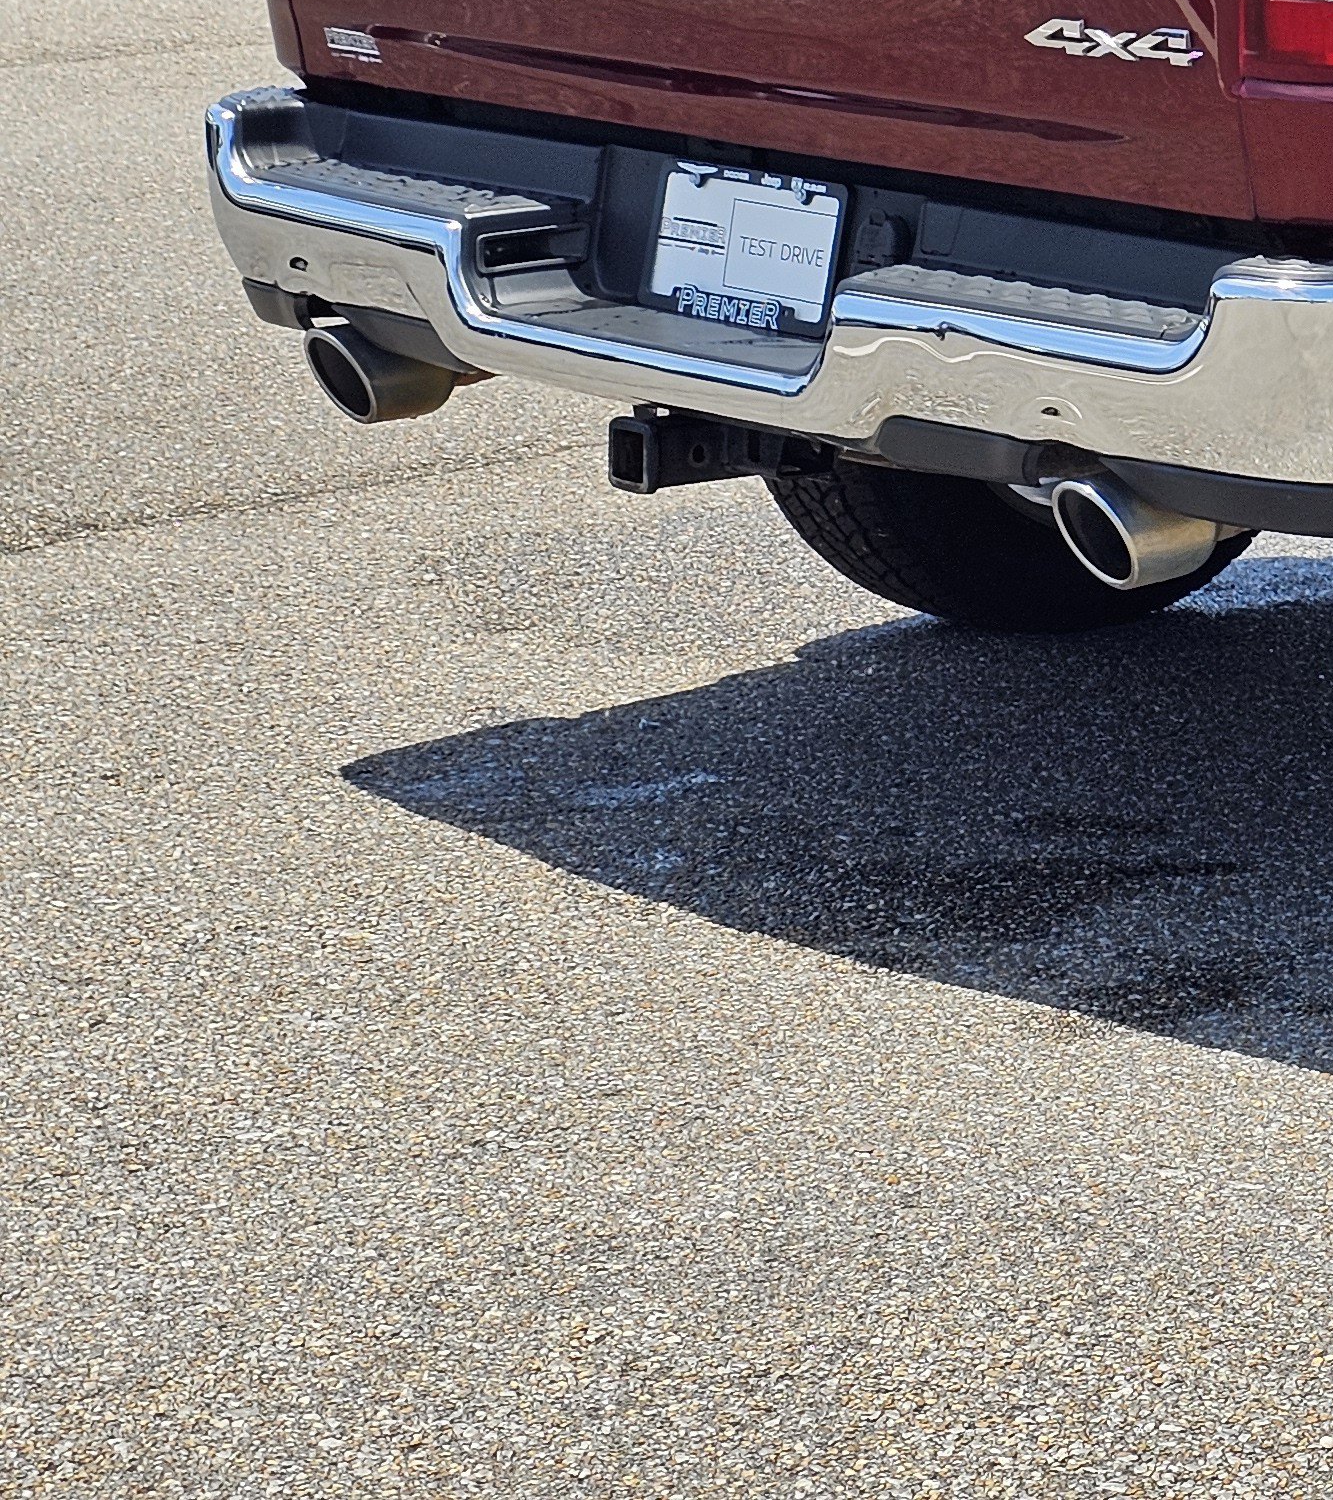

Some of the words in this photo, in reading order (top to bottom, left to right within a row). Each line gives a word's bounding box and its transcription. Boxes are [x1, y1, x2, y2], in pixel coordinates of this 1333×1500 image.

[660, 216, 727, 245] PREMIER
[739, 235, 778, 258] TEST
[780, 243, 825, 268] DRIVE
[677, 282, 780, 330] PREMIER
